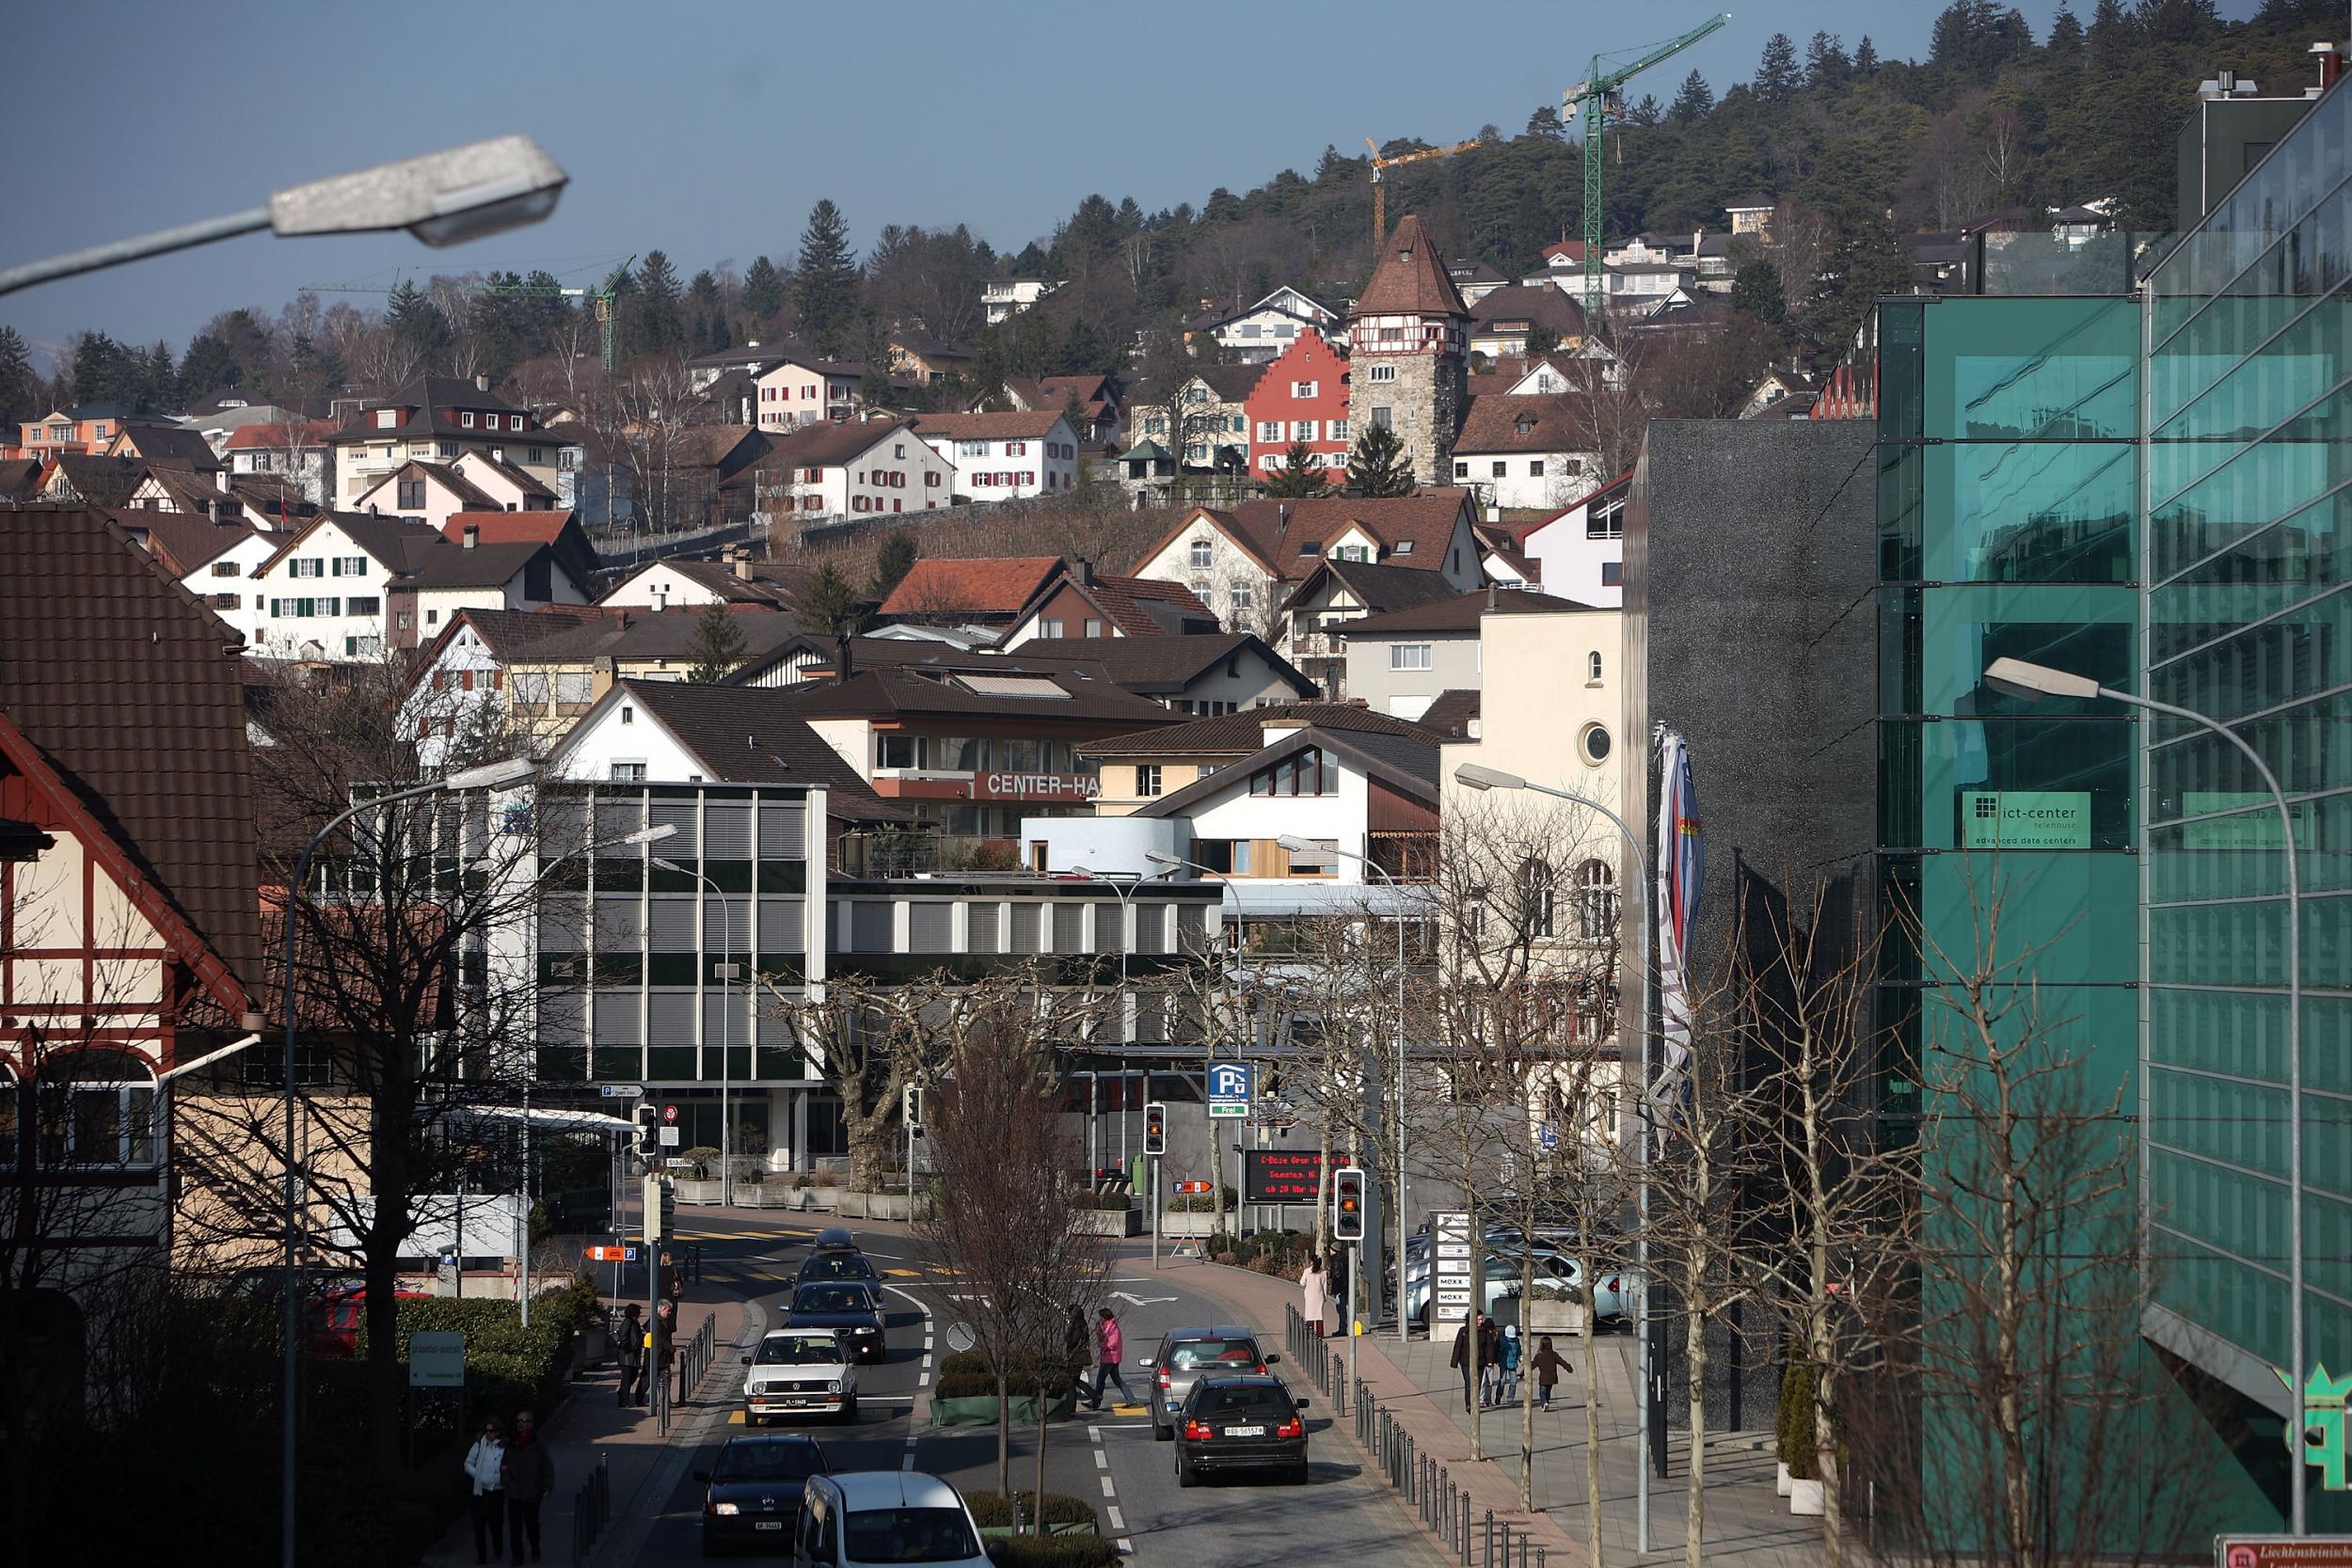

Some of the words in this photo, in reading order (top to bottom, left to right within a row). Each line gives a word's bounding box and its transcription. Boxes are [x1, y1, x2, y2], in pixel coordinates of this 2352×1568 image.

[987, 772, 1100, 795] CENTER-HA
[2003, 808, 2076, 818] ict-center
[1219, 1071, 1234, 1093] P
